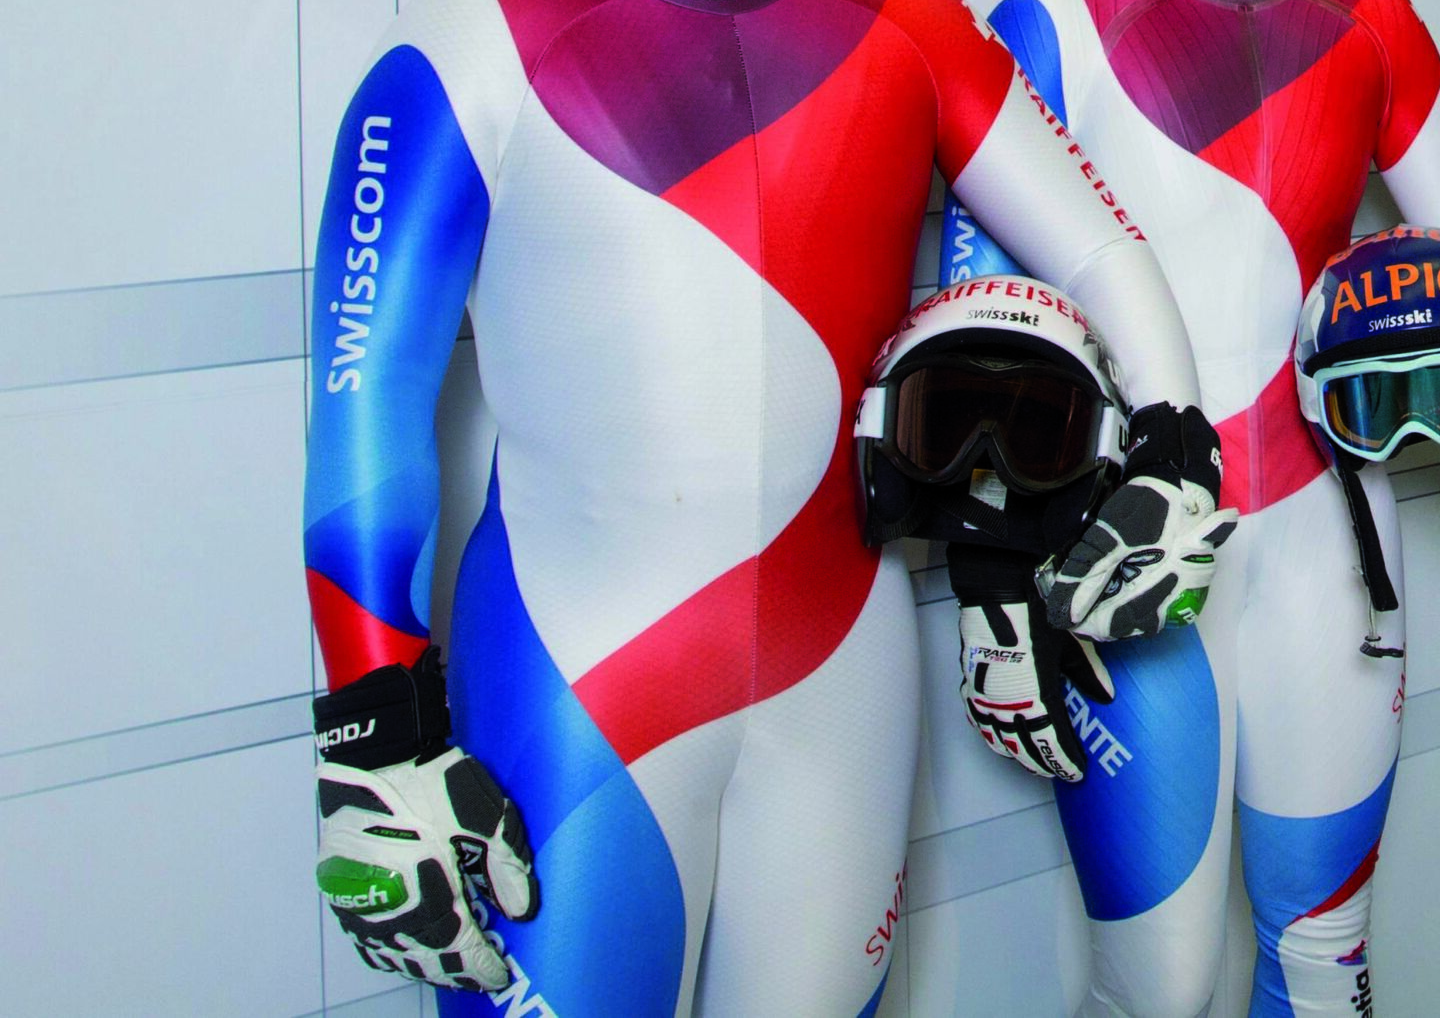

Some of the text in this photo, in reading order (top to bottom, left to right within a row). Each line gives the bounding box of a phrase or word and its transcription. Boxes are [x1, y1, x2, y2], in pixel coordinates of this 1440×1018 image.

[328, 114, 393, 394] swisscom
[966, 306, 1040, 327] swissski
[1368, 308, 1433, 332] swissski
[979, 646, 1027, 659] RACE
[1037, 738, 1079, 781] reusch
